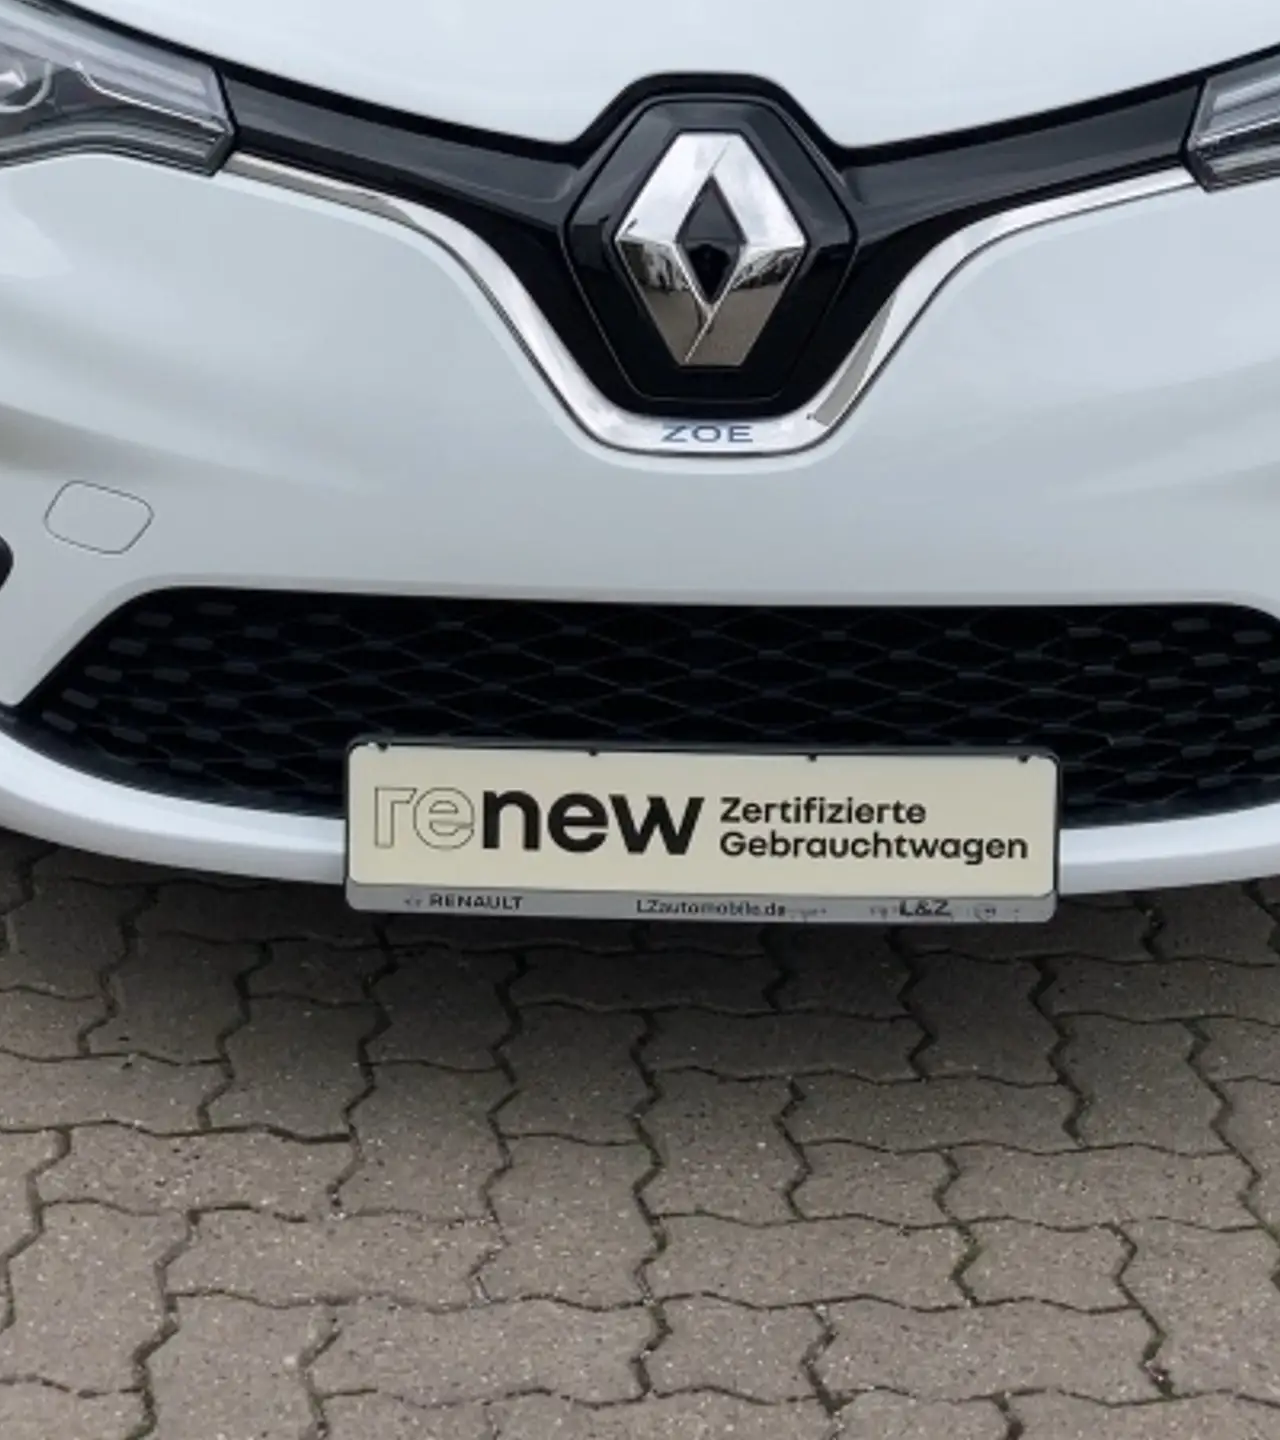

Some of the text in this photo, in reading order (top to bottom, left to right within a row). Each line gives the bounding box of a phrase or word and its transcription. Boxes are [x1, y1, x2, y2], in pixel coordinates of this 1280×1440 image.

[661, 424, 754, 443] ZOE
[374, 786, 705, 856] renew
[719, 796, 927, 826] Zertifizierte
[719, 830, 1029, 866] Gebrauchtwagen
[428, 892, 524, 910] RENAULT
